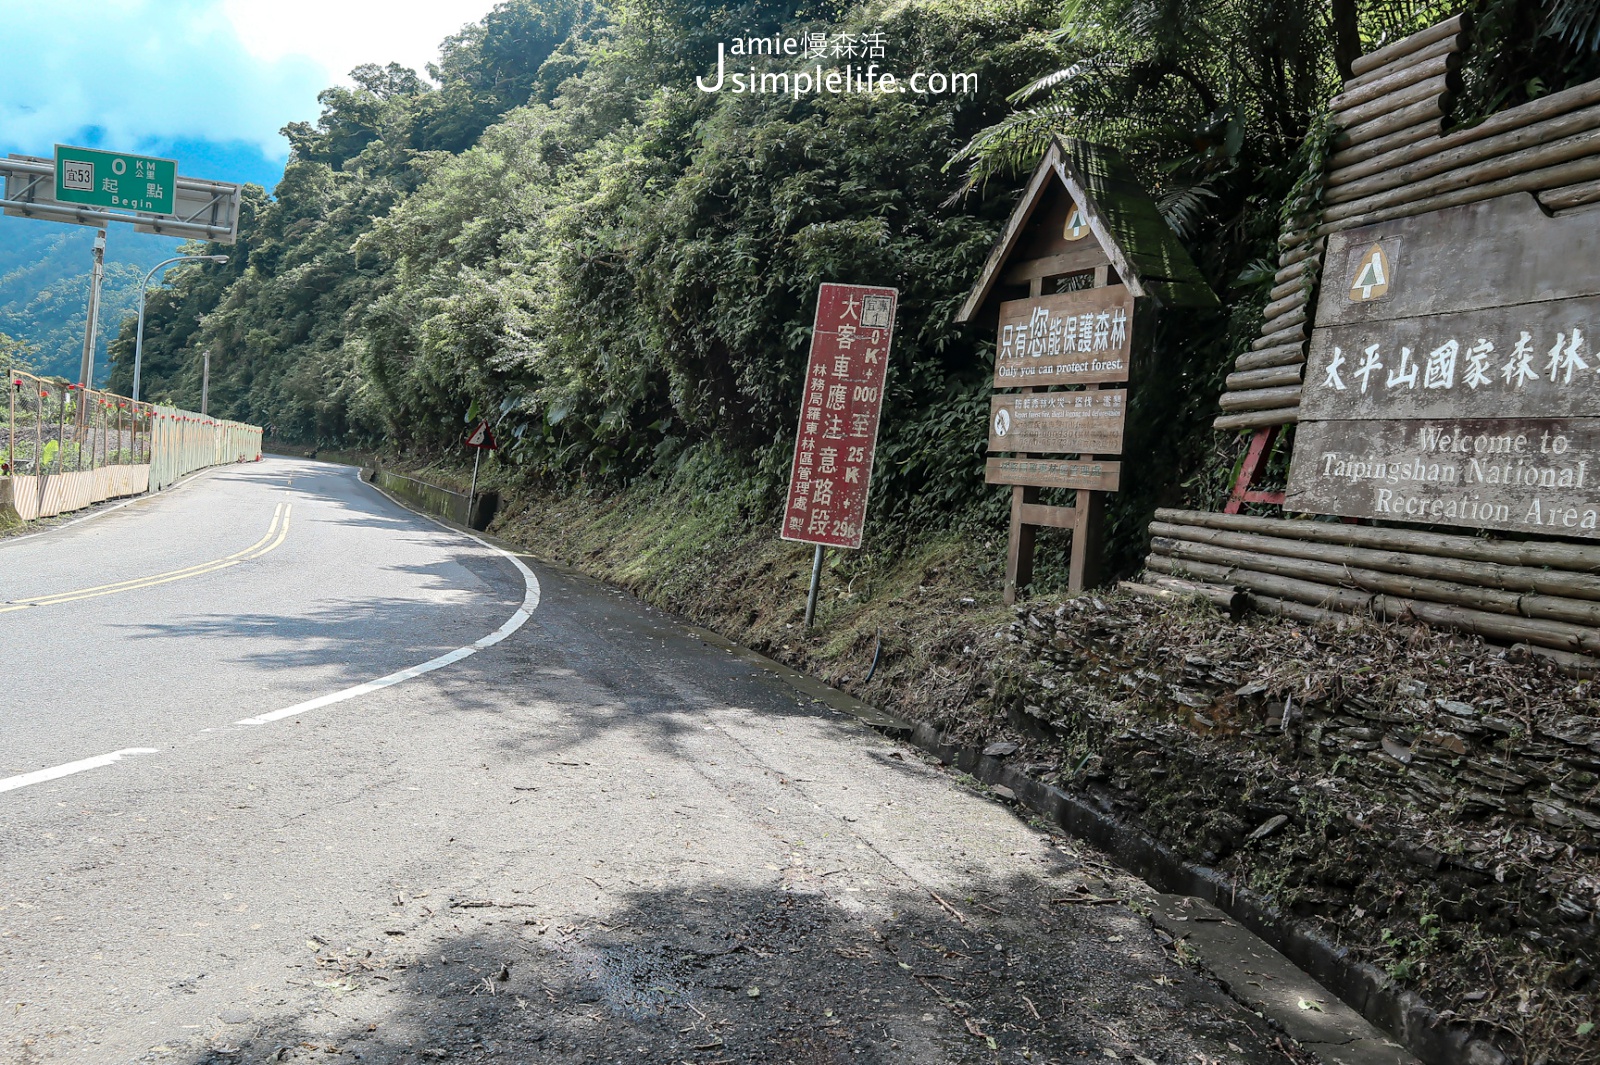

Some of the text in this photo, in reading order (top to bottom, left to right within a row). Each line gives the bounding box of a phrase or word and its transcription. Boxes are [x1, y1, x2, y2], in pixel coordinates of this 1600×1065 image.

[66, 168, 91, 184] 宜53
[102, 177, 163, 199] 起點
[135, 170, 156, 180] 公里
[111, 196, 153, 209] Begin
[1000, 306, 1127, 360] 只有您能保護森林
[998, 365, 1017, 378] Only
[1019, 366, 1036, 377] you
[1038, 364, 1053, 374] can
[1056, 361, 1089, 376] protect
[1320, 327, 1600, 394] 太平山國家森林
[807, 294, 860, 537] 大客車應注意路段
[1419, 427, 1570, 455] Welcome to
[1322, 452, 1587, 489] Taipingshan National
[1374, 488, 1597, 529] Recreation Area
